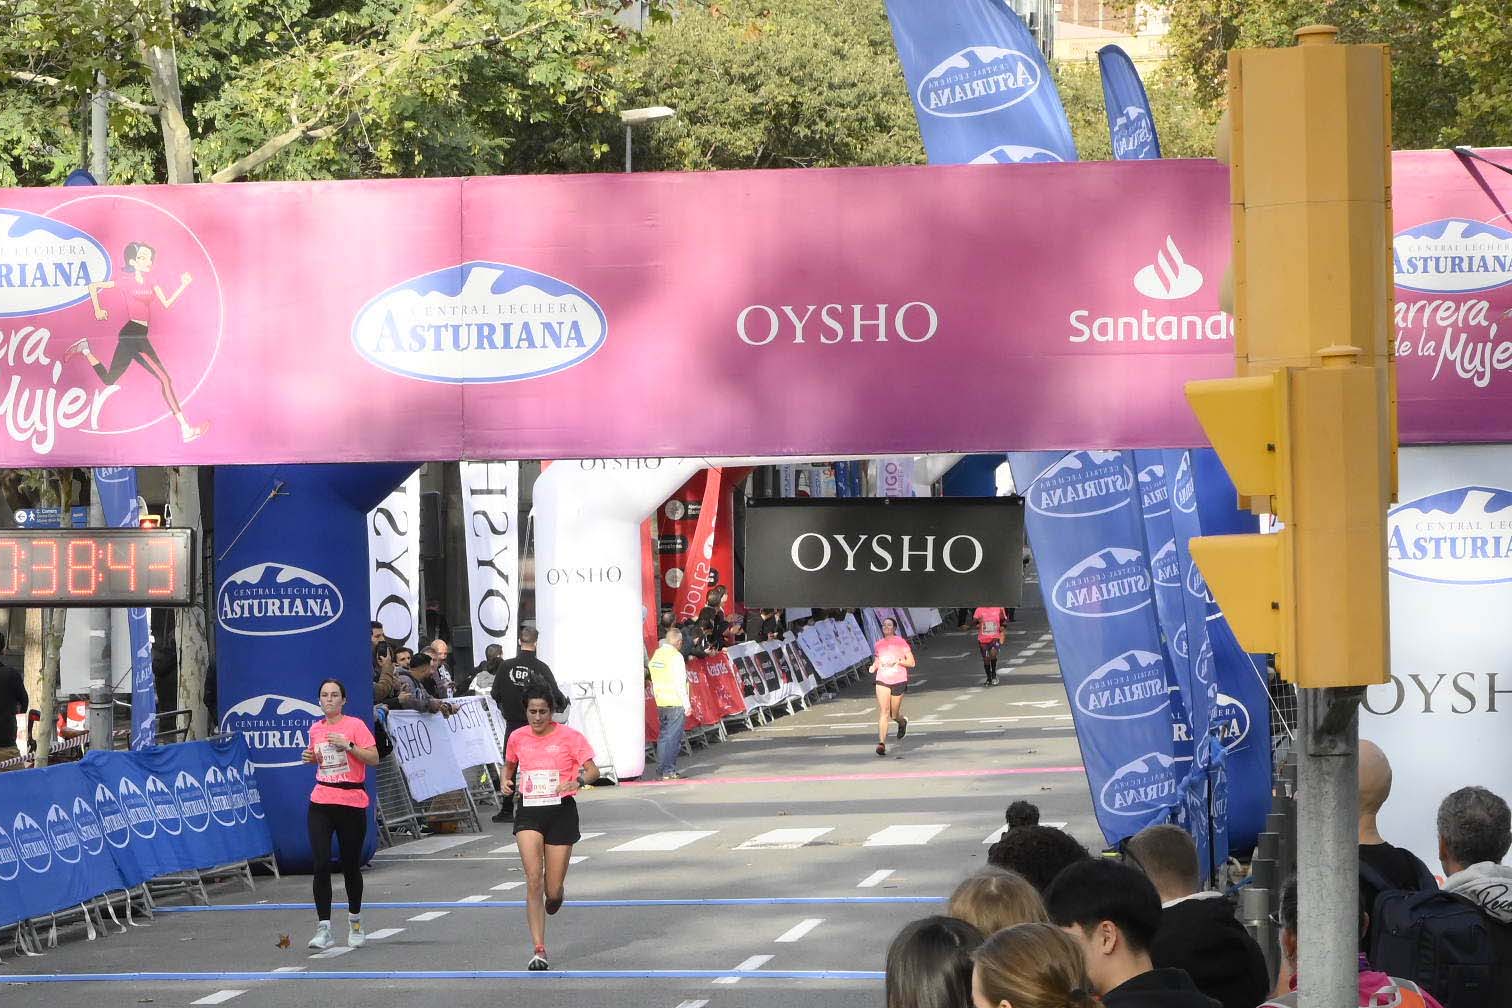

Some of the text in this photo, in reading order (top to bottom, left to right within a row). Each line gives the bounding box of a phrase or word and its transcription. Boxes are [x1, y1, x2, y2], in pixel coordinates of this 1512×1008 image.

[1466, 241, 1512, 252] LECHER
[498, 303, 579, 314] LECHERA
[1394, 299, 1491, 328] arrera
[375, 308, 587, 353] ASTURIANA
[736, 301, 938, 345] OYSHO
[1418, 329, 1435, 357] la
[1431, 323, 1512, 388] Muje
[1415, 519, 1482, 530] CENTRAL
[790, 532, 984, 574] OYSHO
[546, 565, 622, 585] OYSHO
[234, 588, 329, 596] CENTRAL LECHERA
[221, 594, 334, 620] ASTURIANA
[575, 679, 625, 697] SHO
[235, 719, 317, 728] CENTRAL LECHE
